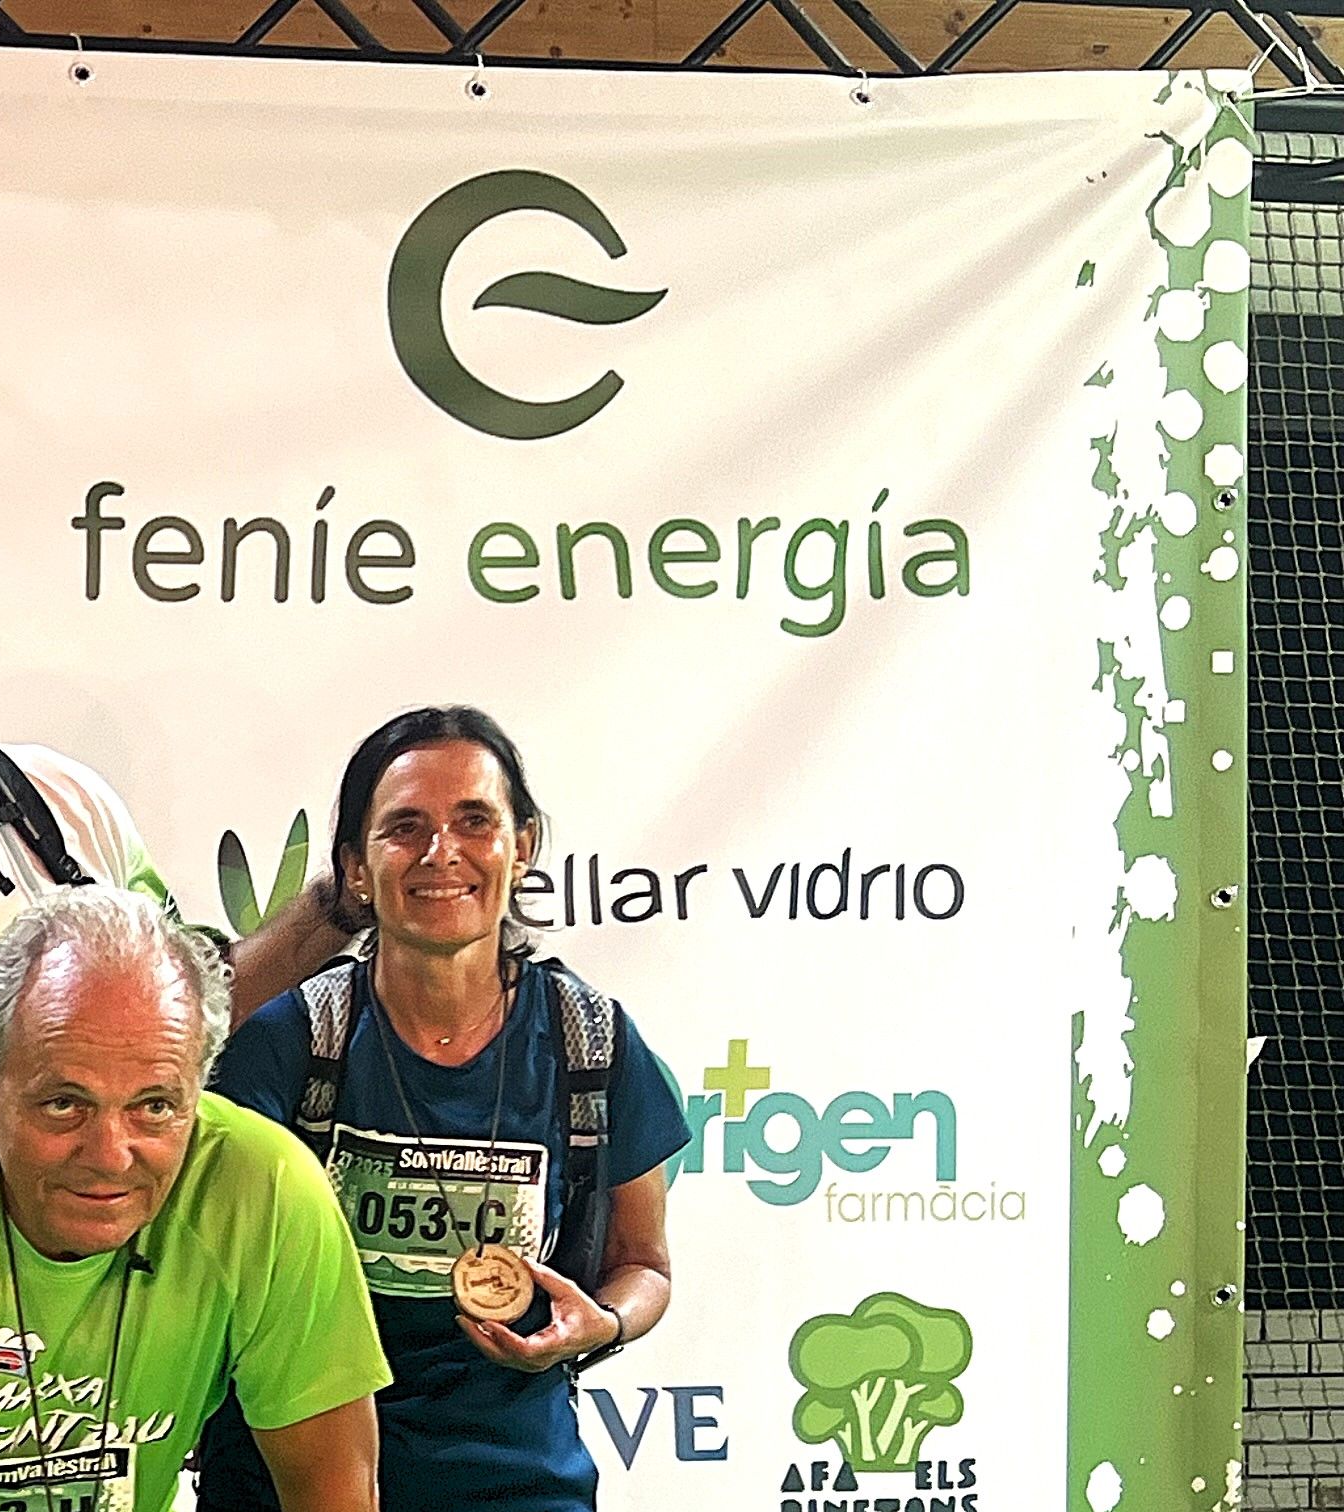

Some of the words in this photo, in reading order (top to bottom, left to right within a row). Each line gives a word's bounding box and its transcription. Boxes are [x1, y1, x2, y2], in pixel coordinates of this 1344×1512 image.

[72, 481, 416, 604] feníe
[466, 488, 970, 637] energía
[356, 1191, 507, 1244] 053-C
[825, 1182, 1027, 1223] farmàcia
[780, 1460, 859, 1493] AFA
[915, 1458, 977, 1490] ELS
